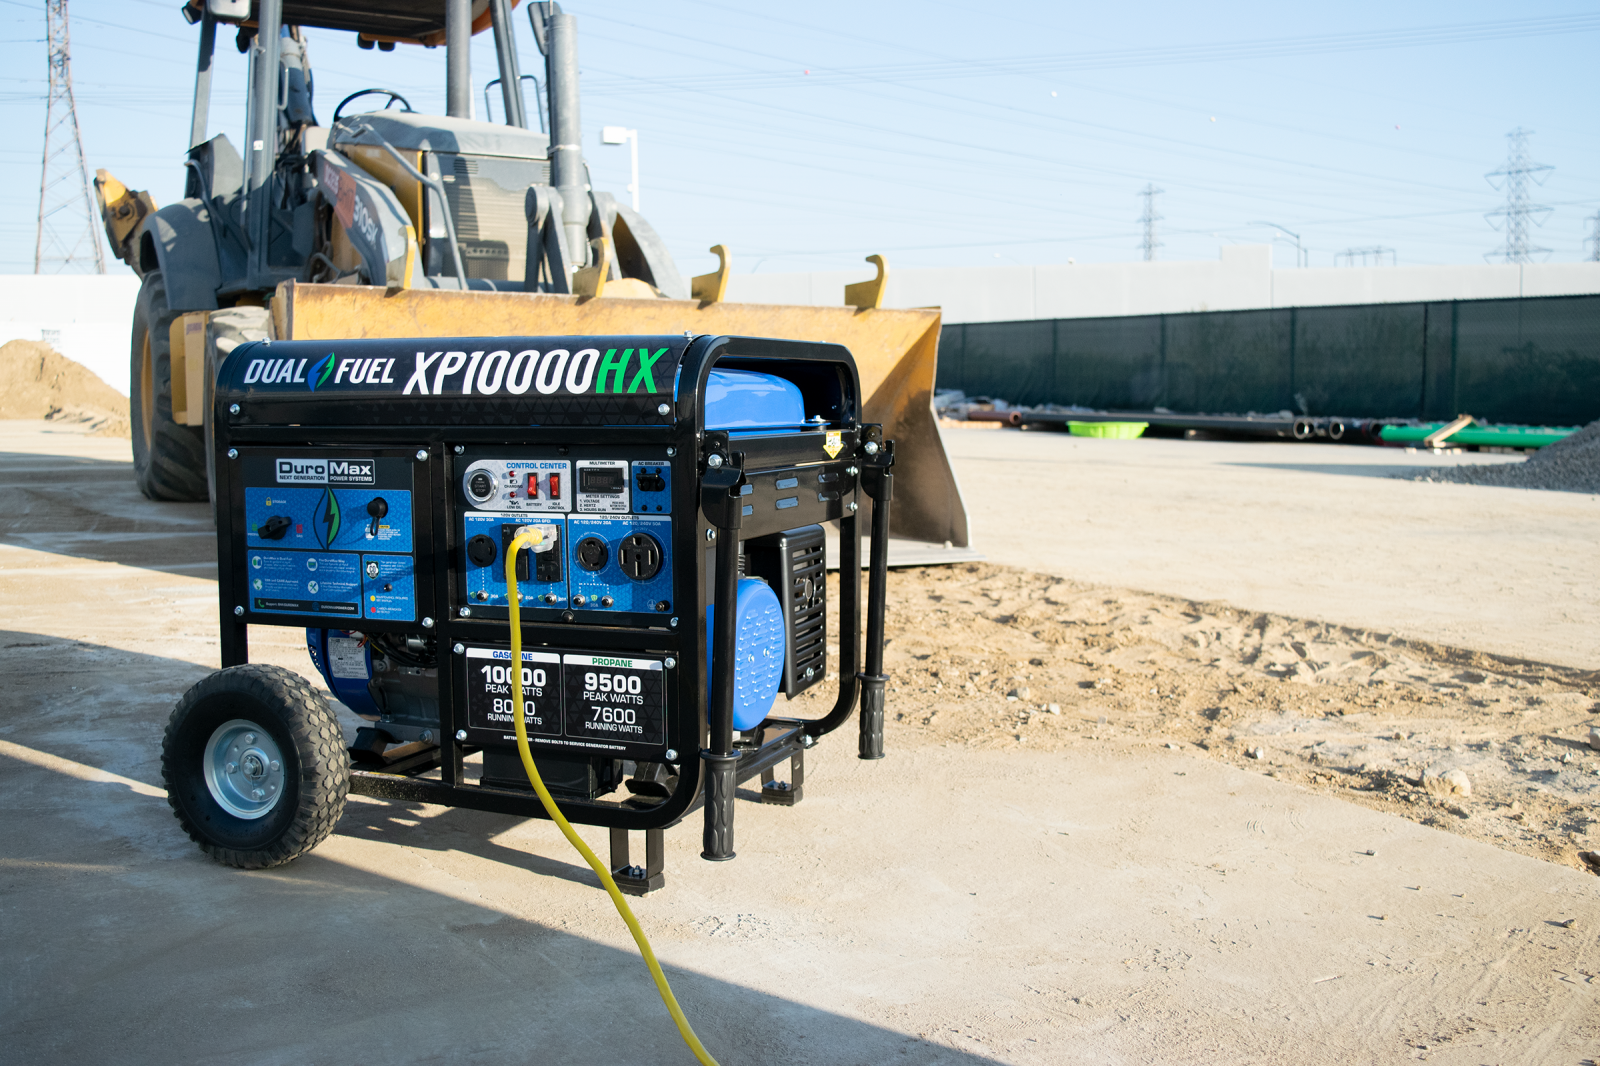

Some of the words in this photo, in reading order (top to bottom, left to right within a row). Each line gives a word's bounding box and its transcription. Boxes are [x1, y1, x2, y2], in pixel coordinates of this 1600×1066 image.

[244, 358, 308, 384] DUAL
[334, 358, 396, 384] FUEL
[402, 348, 668, 395] XP10000HX
[492, 651, 532, 660] GASNE
[592, 657, 633, 667] PROPANE
[584, 672, 641, 694] 9500
[486, 684, 509, 694] PEAK
[511, 686, 542, 696] ATTS
[583, 691, 608, 702] PEAK
[610, 693, 643, 705] WATTS
[494, 698, 535, 716] 800
[488, 713, 514, 722] RUNNIN
[522, 716, 542, 725] ATTS
[591, 706, 636, 724] 7600
[585, 721, 617, 731] RUNNING
[618, 724, 643, 734] WATTS
